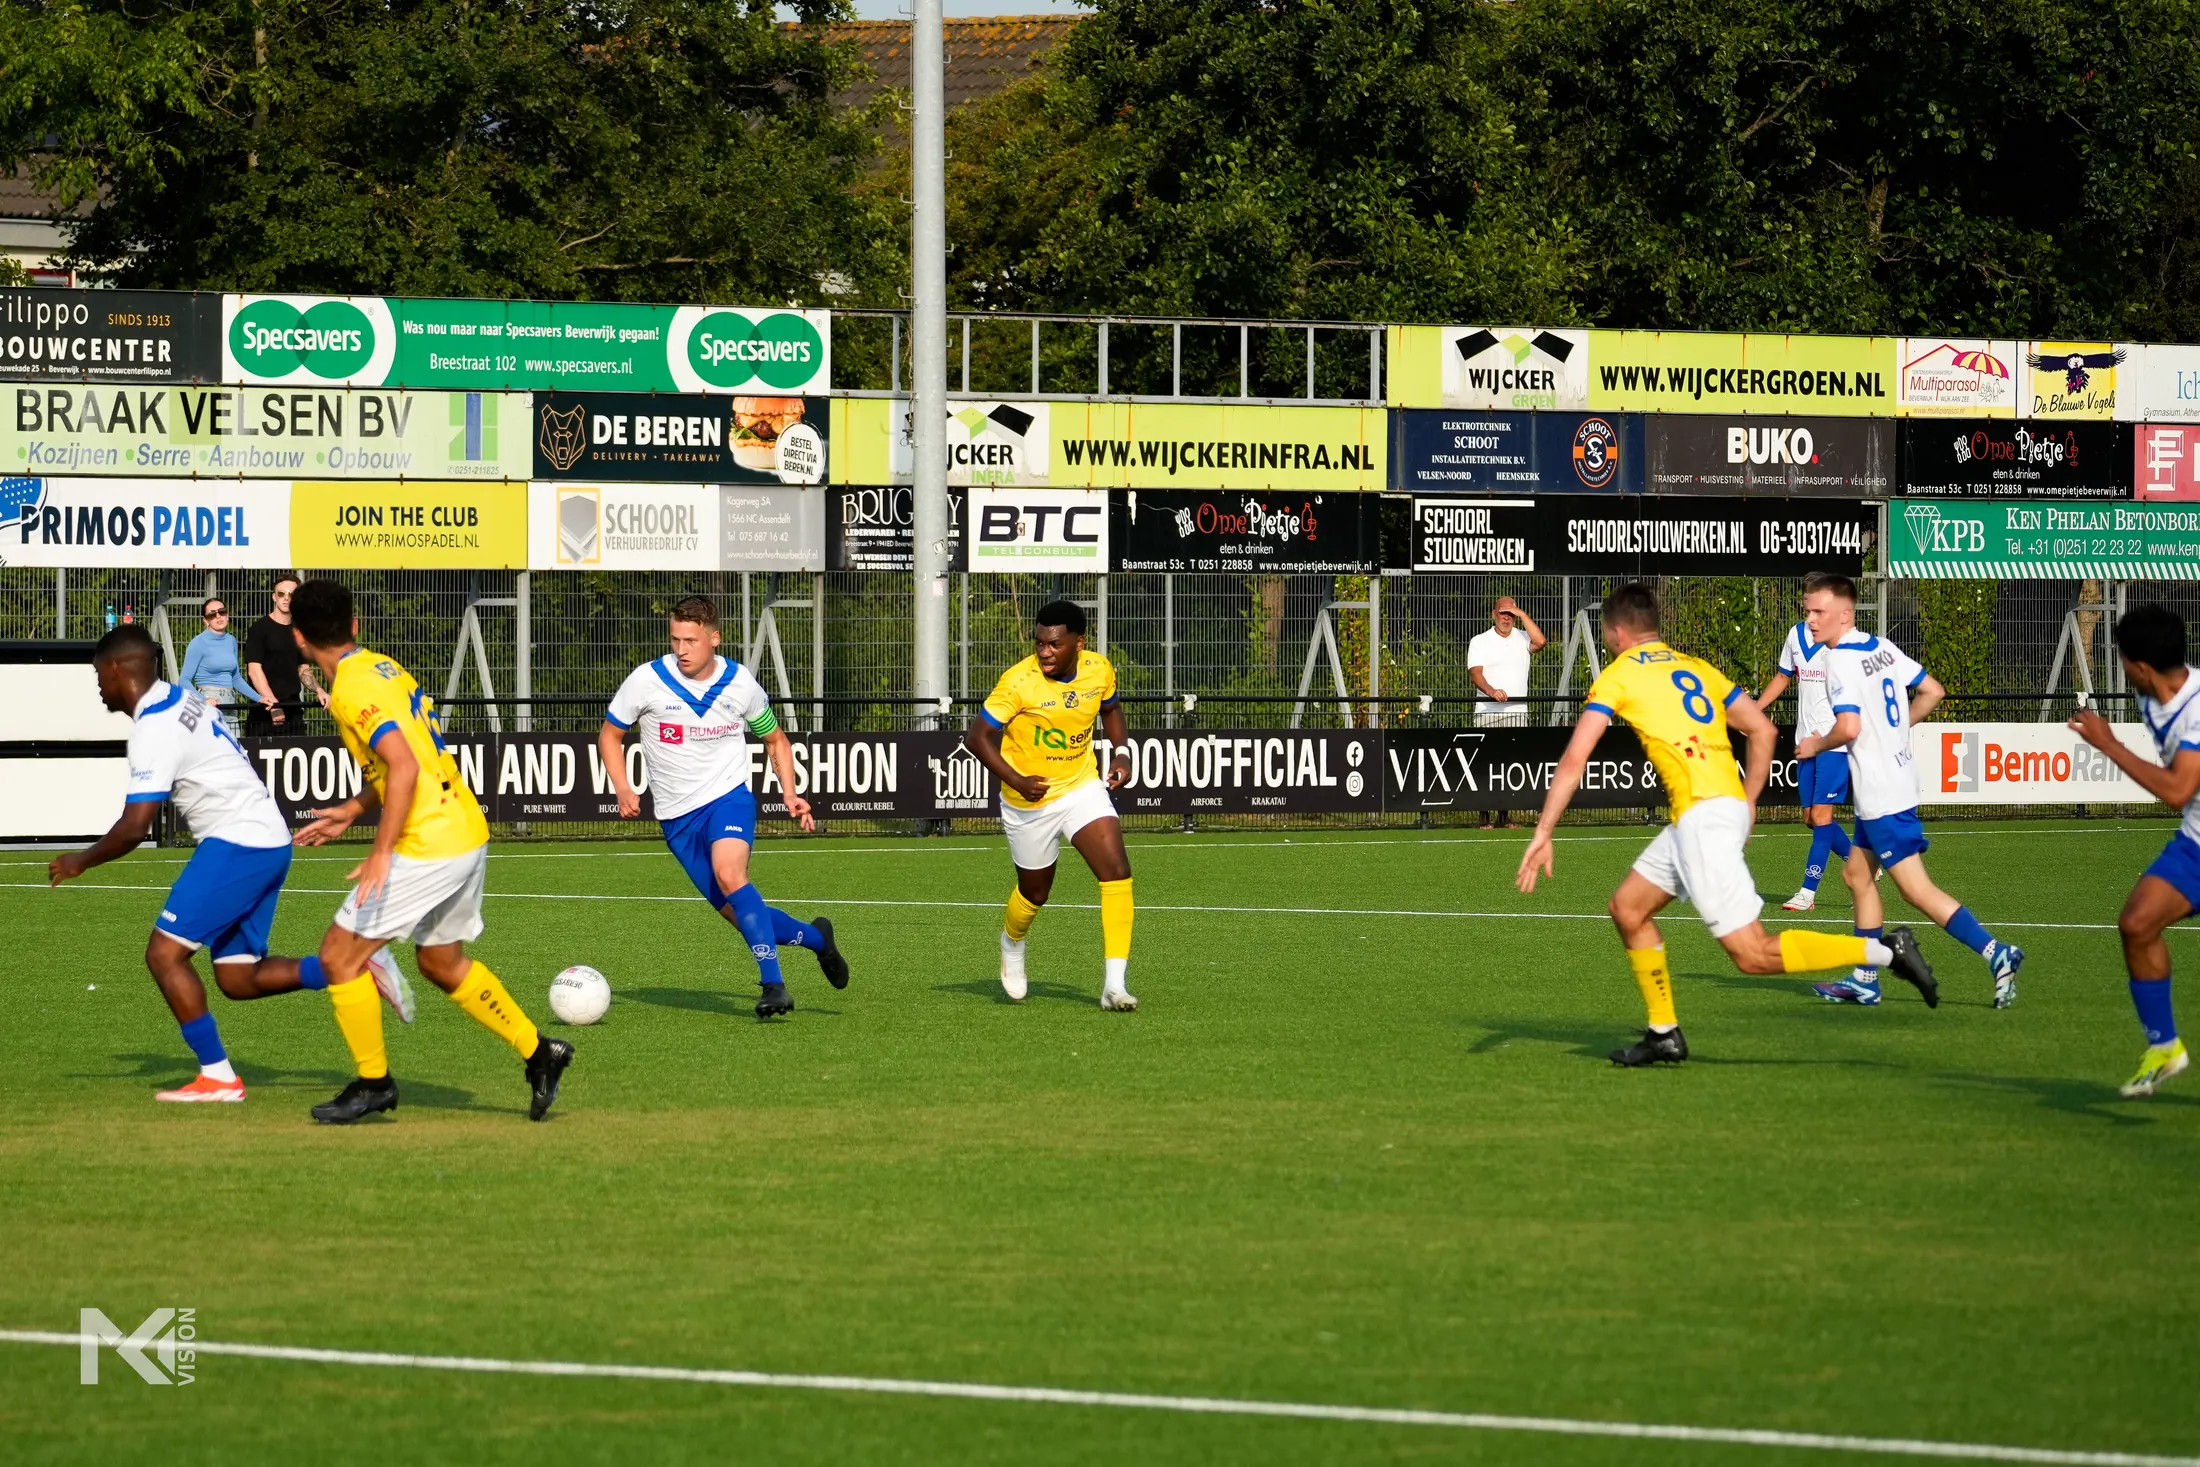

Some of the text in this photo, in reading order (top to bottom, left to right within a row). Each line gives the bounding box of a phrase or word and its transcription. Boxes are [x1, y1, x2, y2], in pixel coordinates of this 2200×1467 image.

[108, 313, 171, 327] SINDS 1913
[243, 321, 362, 355] Specsavers
[403, 320, 660, 343] Was nou maar naar Specsavers Beverwijk gegaan!
[700, 333, 811, 366] Specsavers
[31, 365, 40, 374] 25
[48, 365, 80, 375] Beverwijk
[430, 353, 633, 376] Breestraat 102 www.specsavers.nl
[1469, 367, 1555, 394] WIJCKER
[1599, 366, 1886, 400] WWW.WIJCKERGROEN.NL
[1909, 375, 1980, 397] Multiparasol
[1511, 394, 1556, 408] GROEN
[2033, 390, 2116, 415] De Blauwe Vogels
[16, 388, 413, 439] BRAAK VELSEN BV
[593, 415, 721, 447] DE BEREN
[1442, 421, 1512, 432] ELEKTROTECHNIEK
[1579, 422, 1612, 440] SCHOOT
[790, 436, 813, 450] BESTEL
[1454, 435, 1500, 450] SCHOOT
[28, 441, 412, 471] Kozijnen Serre Aanbouw Opbouw
[593, 451, 721, 463] DELIVERY TAKEAWAY
[783, 448, 818, 465] DIRECT VIA
[1063, 439, 1376, 476] WWW.WIJCKERINFRA.NL
[1431, 454, 1526, 465] INSTALLATIETECHNIEK B.V.
[455, 465, 500, 477] 0251-211825
[784, 461, 814, 476] BEREN.NL
[970, 469, 1016, 484] INFRA
[1417, 470, 1540, 481] VELSEN-NOORD HEEMSKERK
[1992, 470, 2041, 480] eten & drinken
[1654, 474, 1887, 487] TRANSPORT HUISVESTING MATERIEEL INFRASUPPORT VEILIGHEID
[1907, 483, 2127, 498] Baanstraat 53c T 0251 228858 www.omepietjebeverwijk.nl
[335, 505, 479, 527] JOIN THE CLUB
[605, 503, 699, 535] SCHOORL
[727, 513, 791, 525] 1566 NC Assendelft
[980, 506, 1102, 542] BTC
[1423, 508, 1494, 535] SCHOORL
[2113, 510, 2200, 532] BETONBOR
[20, 505, 249, 546] PRIMOS PADEL
[335, 532, 480, 548] WWW.PRIMOSPADEL.NL
[605, 536, 699, 552] VERHUURBEDRIJF CV
[739, 532, 789, 542] 075 687 16 42
[1567, 519, 1862, 555] SCHOORLSTUQWERKEN.NL 06-30317444
[1932, 519, 1986, 552] KPB
[992, 546, 1084, 557] TELCONSULT
[1220, 543, 1274, 555] eten & drinken
[1423, 536, 1525, 564] STUQWERKEN
[2005, 538, 2025, 556] Tel.
[2028, 540, 2049, 556] +31
[2053, 539, 2087, 559] (0)251
[2091, 540, 2107, 556] 22
[2109, 540, 2124, 556] 23
[2127, 540, 2142, 557] 22
[1122, 558, 1373, 574] Baanstraat 53c T 0251 228858 www.omepietjebeverwijk.nl
[1671, 669, 1715, 725] 8
[1882, 677, 1901, 728] 8
[689, 721, 740, 737] RUMPING
[499, 743, 575, 796] AND
[1388, 747, 1479, 793] VIXX
[1489, 759, 1657, 791] HOVEIERS &
[524, 803, 567, 814] PURE WHITE
[832, 802, 895, 812] COLOURFUL REBEL
[1137, 796, 1287, 806] REPLAY AIRFORCE KRAKATAU
